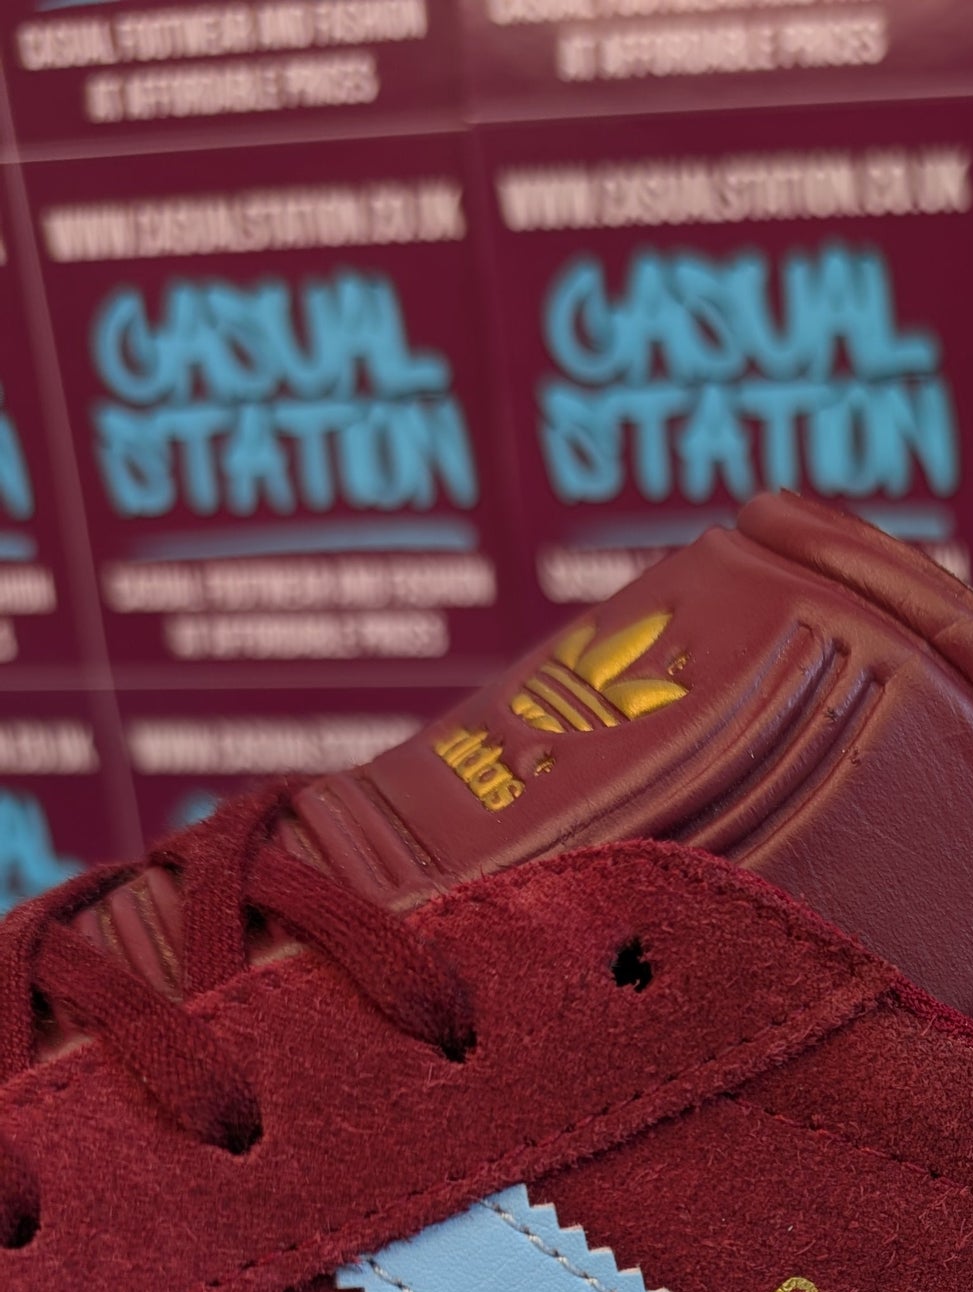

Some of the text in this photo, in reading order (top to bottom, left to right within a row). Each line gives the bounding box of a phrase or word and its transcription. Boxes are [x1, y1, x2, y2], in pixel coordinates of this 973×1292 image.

[90, 268, 452, 402] CASUAL
[543, 240, 942, 387] CASUAL
[92, 393, 480, 518] STATION
[537, 372, 960, 504] STATION
